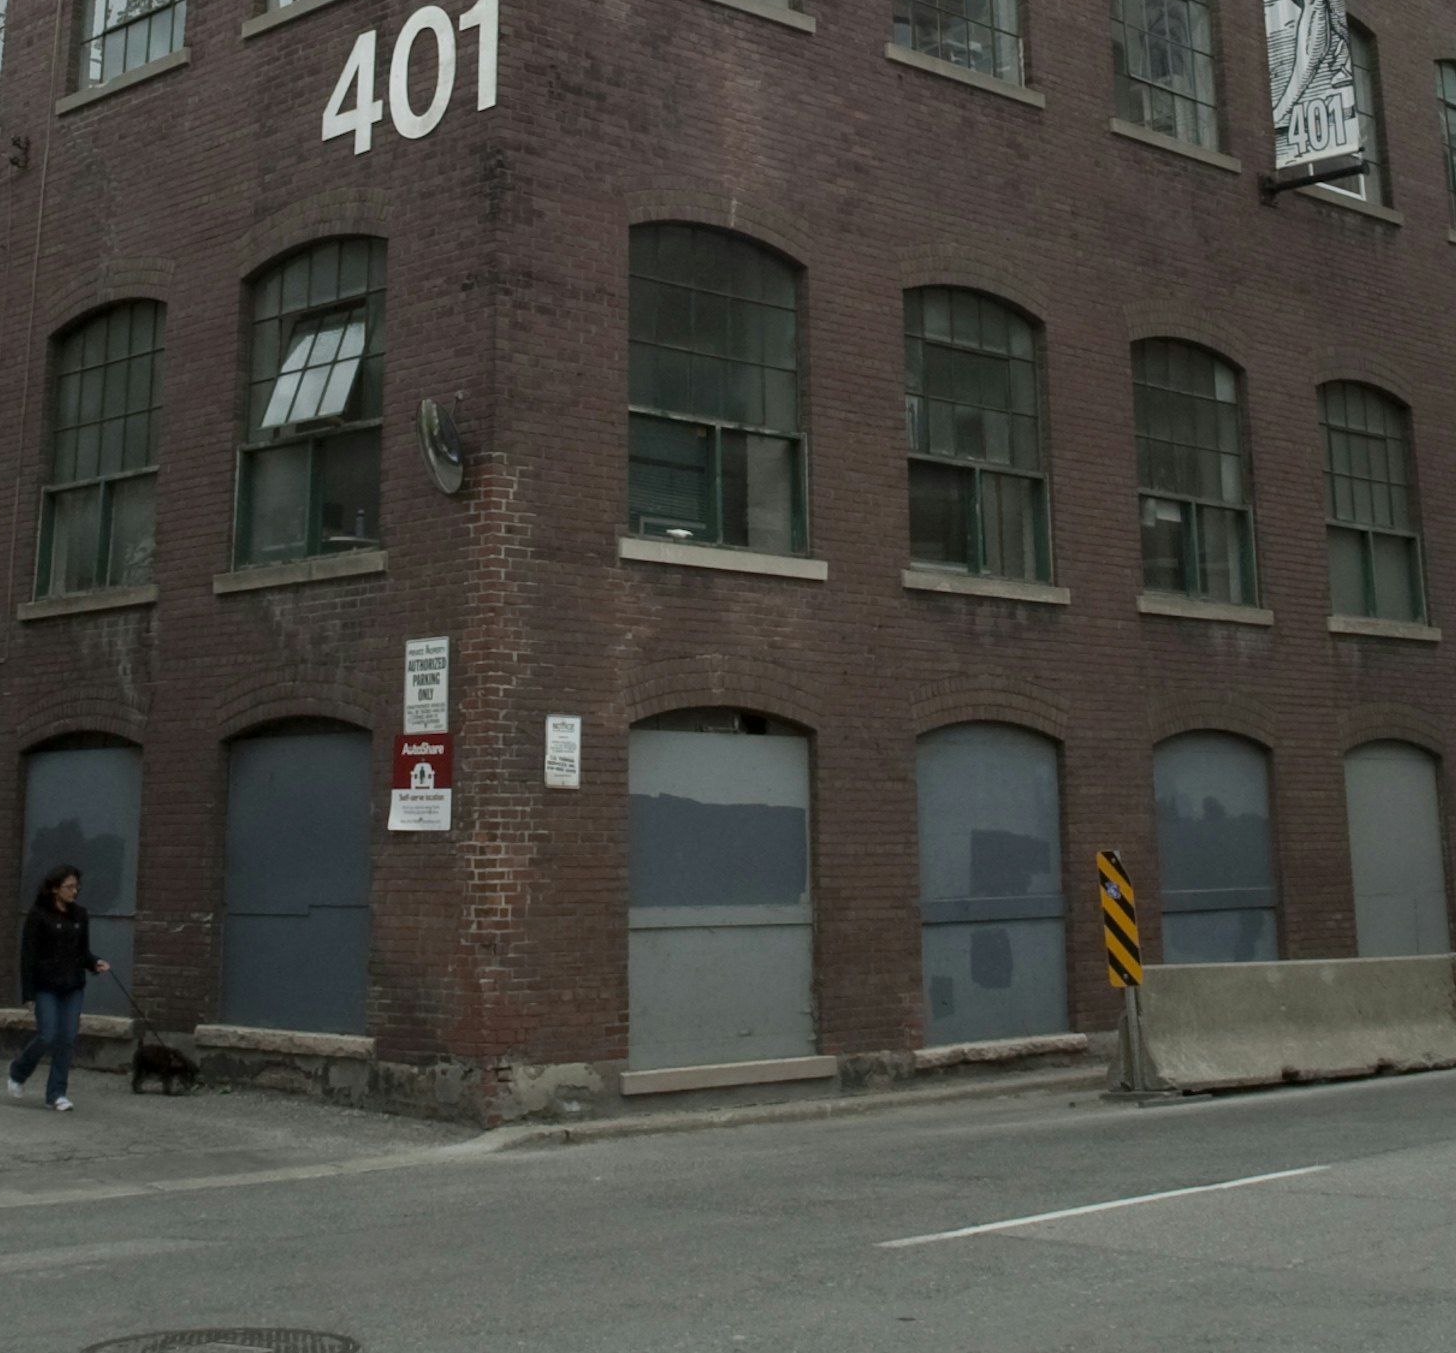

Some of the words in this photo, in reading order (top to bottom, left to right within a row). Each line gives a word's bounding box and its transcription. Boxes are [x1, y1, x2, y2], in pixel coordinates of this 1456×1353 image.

[1287, 93, 1347, 157] 401
[408, 657, 446, 672] AUTHORIZED
[412, 672, 441, 687] PARKING
[418, 688, 434, 701] ONLY
[402, 742, 444, 755] AutoShare
